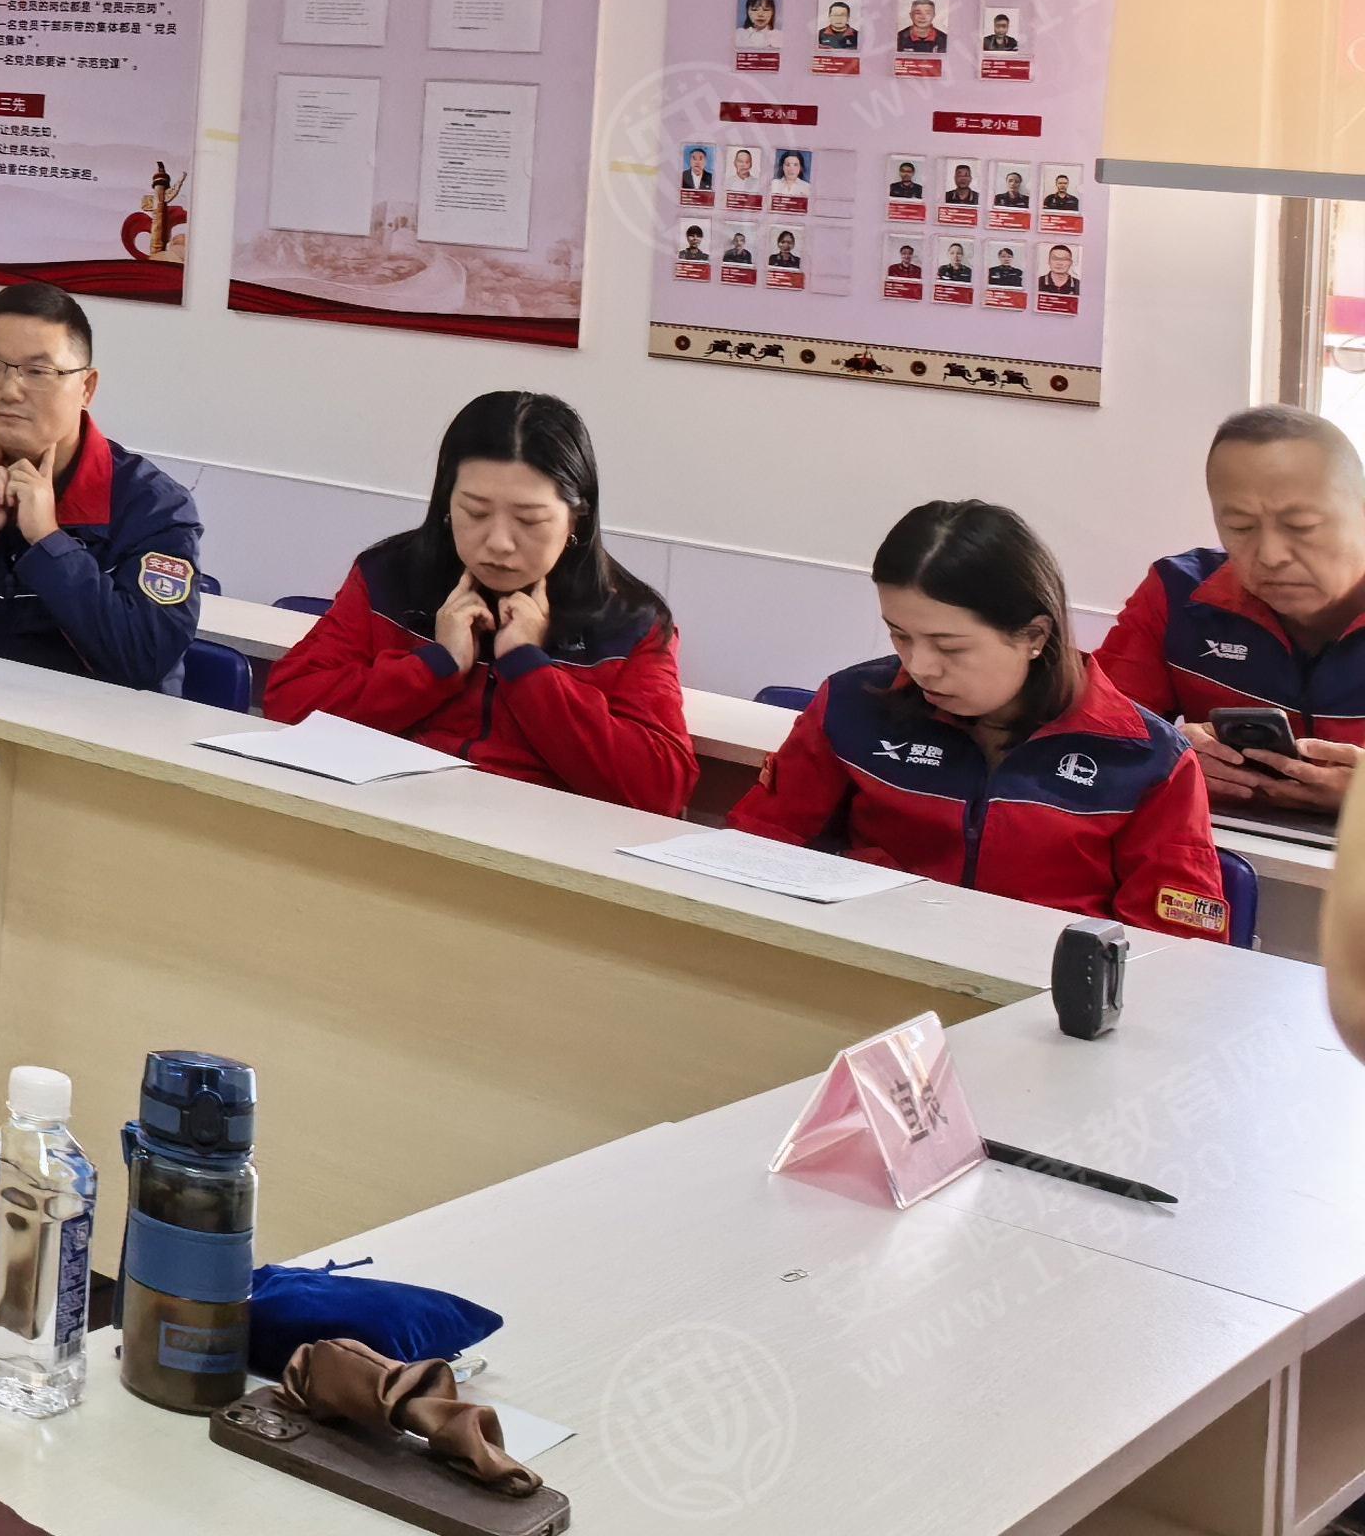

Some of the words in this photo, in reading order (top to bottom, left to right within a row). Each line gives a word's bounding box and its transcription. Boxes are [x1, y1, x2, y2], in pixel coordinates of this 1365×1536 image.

[740, 107, 797, 120] 第一党小组
[955, 117, 1019, 131] 第二党小组
